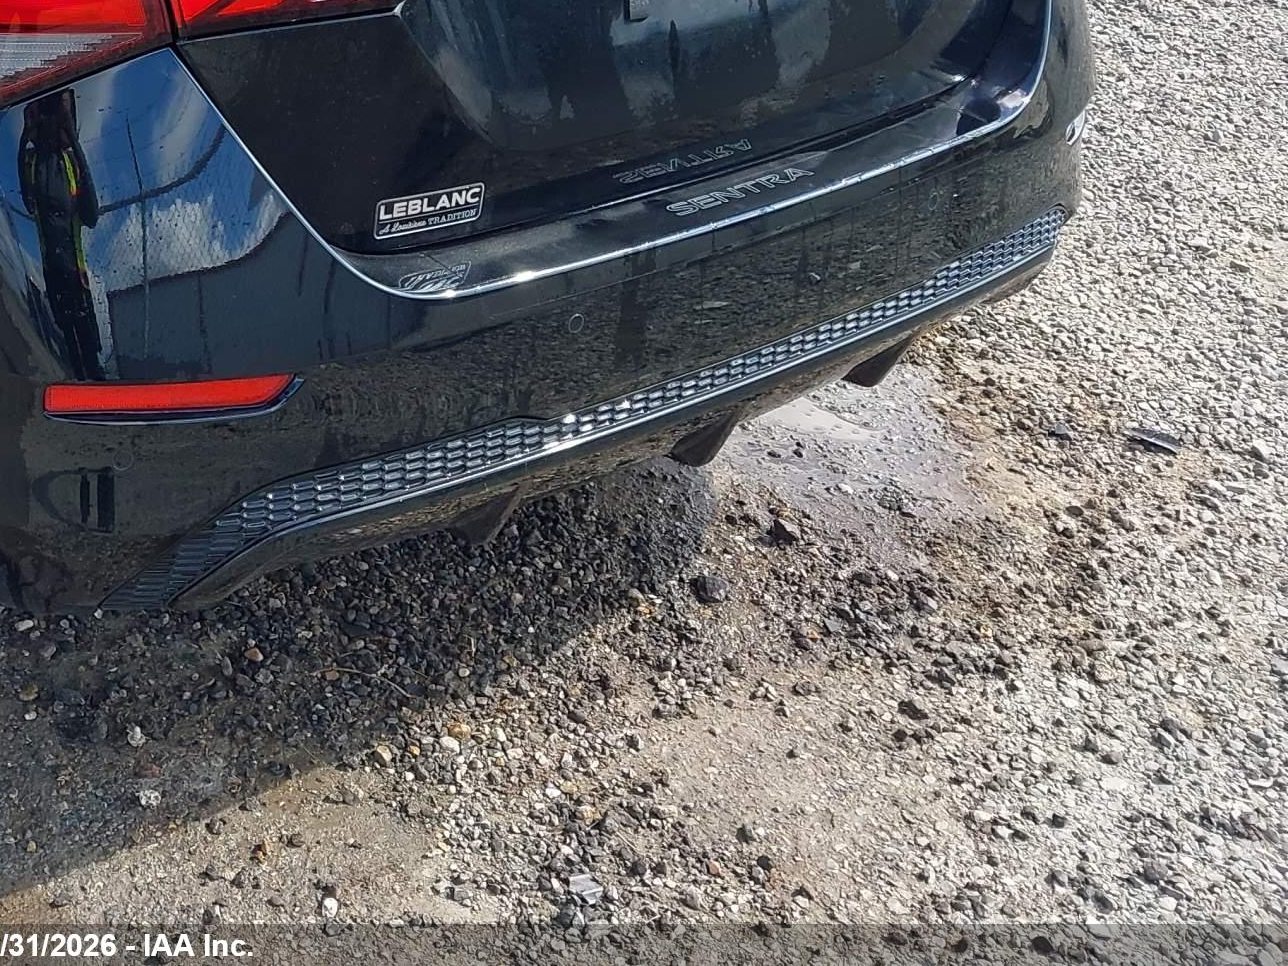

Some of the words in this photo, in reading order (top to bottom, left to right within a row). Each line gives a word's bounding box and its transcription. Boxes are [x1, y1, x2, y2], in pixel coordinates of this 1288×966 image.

[379, 187, 481, 221] LEBLANC
[665, 166, 815, 217] SENTRA
[428, 208, 477, 225] TRADITION
